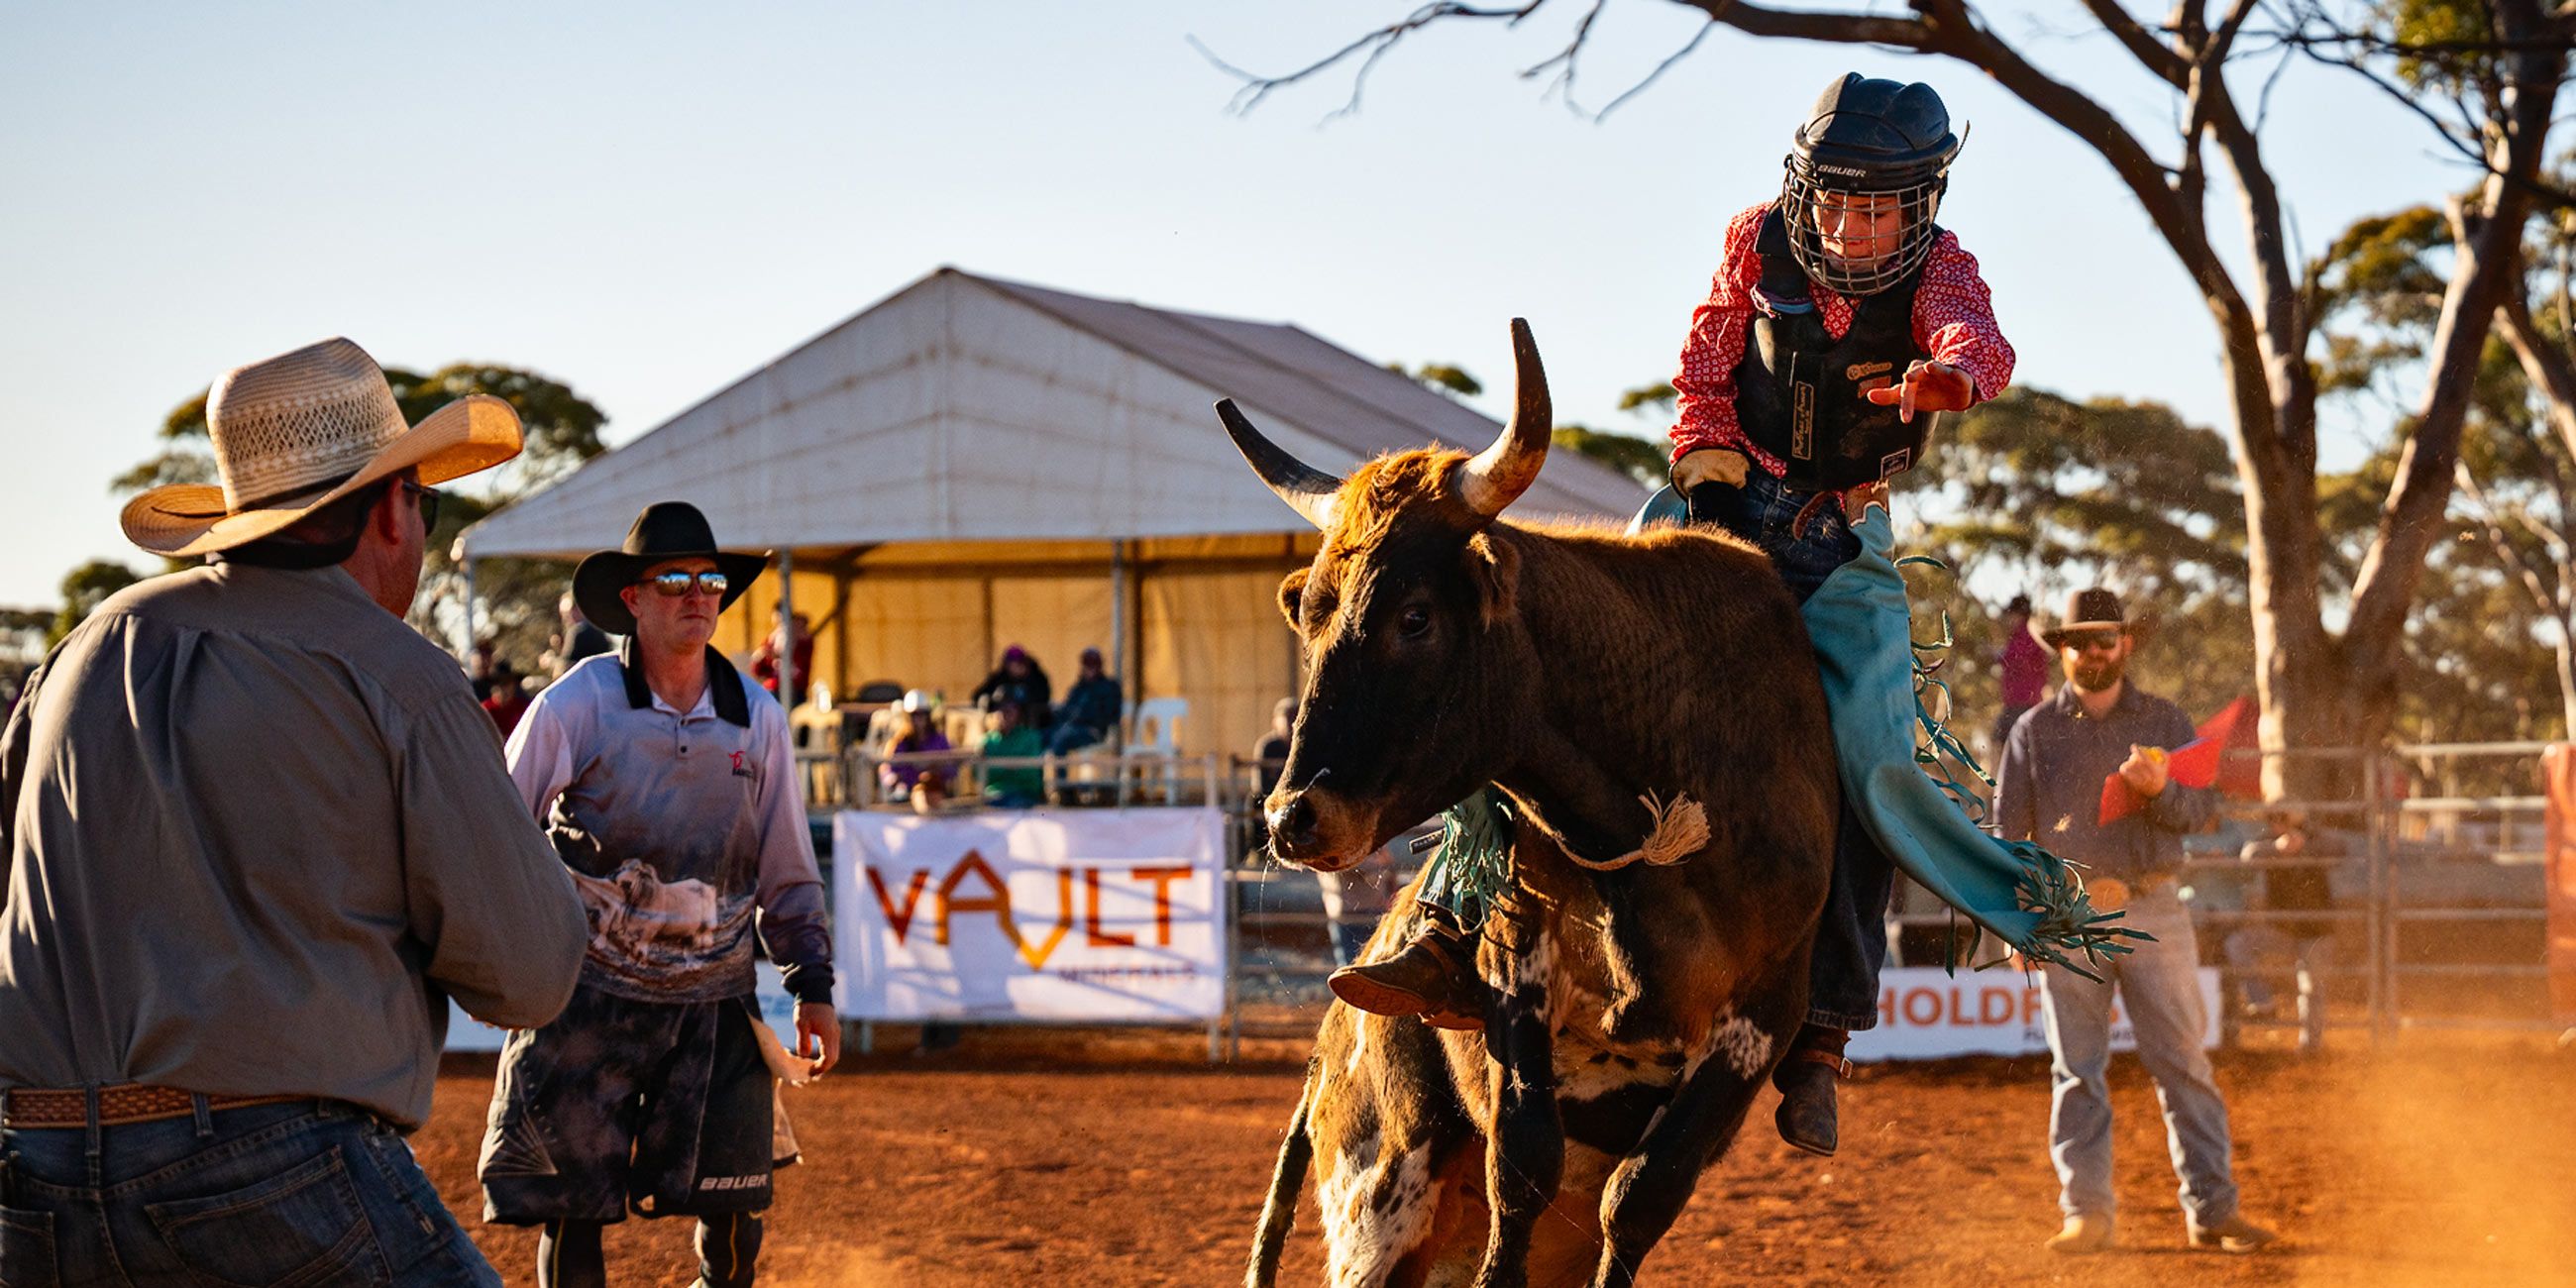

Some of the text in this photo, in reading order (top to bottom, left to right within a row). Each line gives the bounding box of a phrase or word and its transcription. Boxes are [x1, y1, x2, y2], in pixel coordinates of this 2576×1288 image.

[1817, 163, 1867, 177] BAUER
[865, 848, 1193, 971] VAULT
[1878, 986, 2118, 1026] HOLDF
[698, 1174, 768, 1191] BAUER
